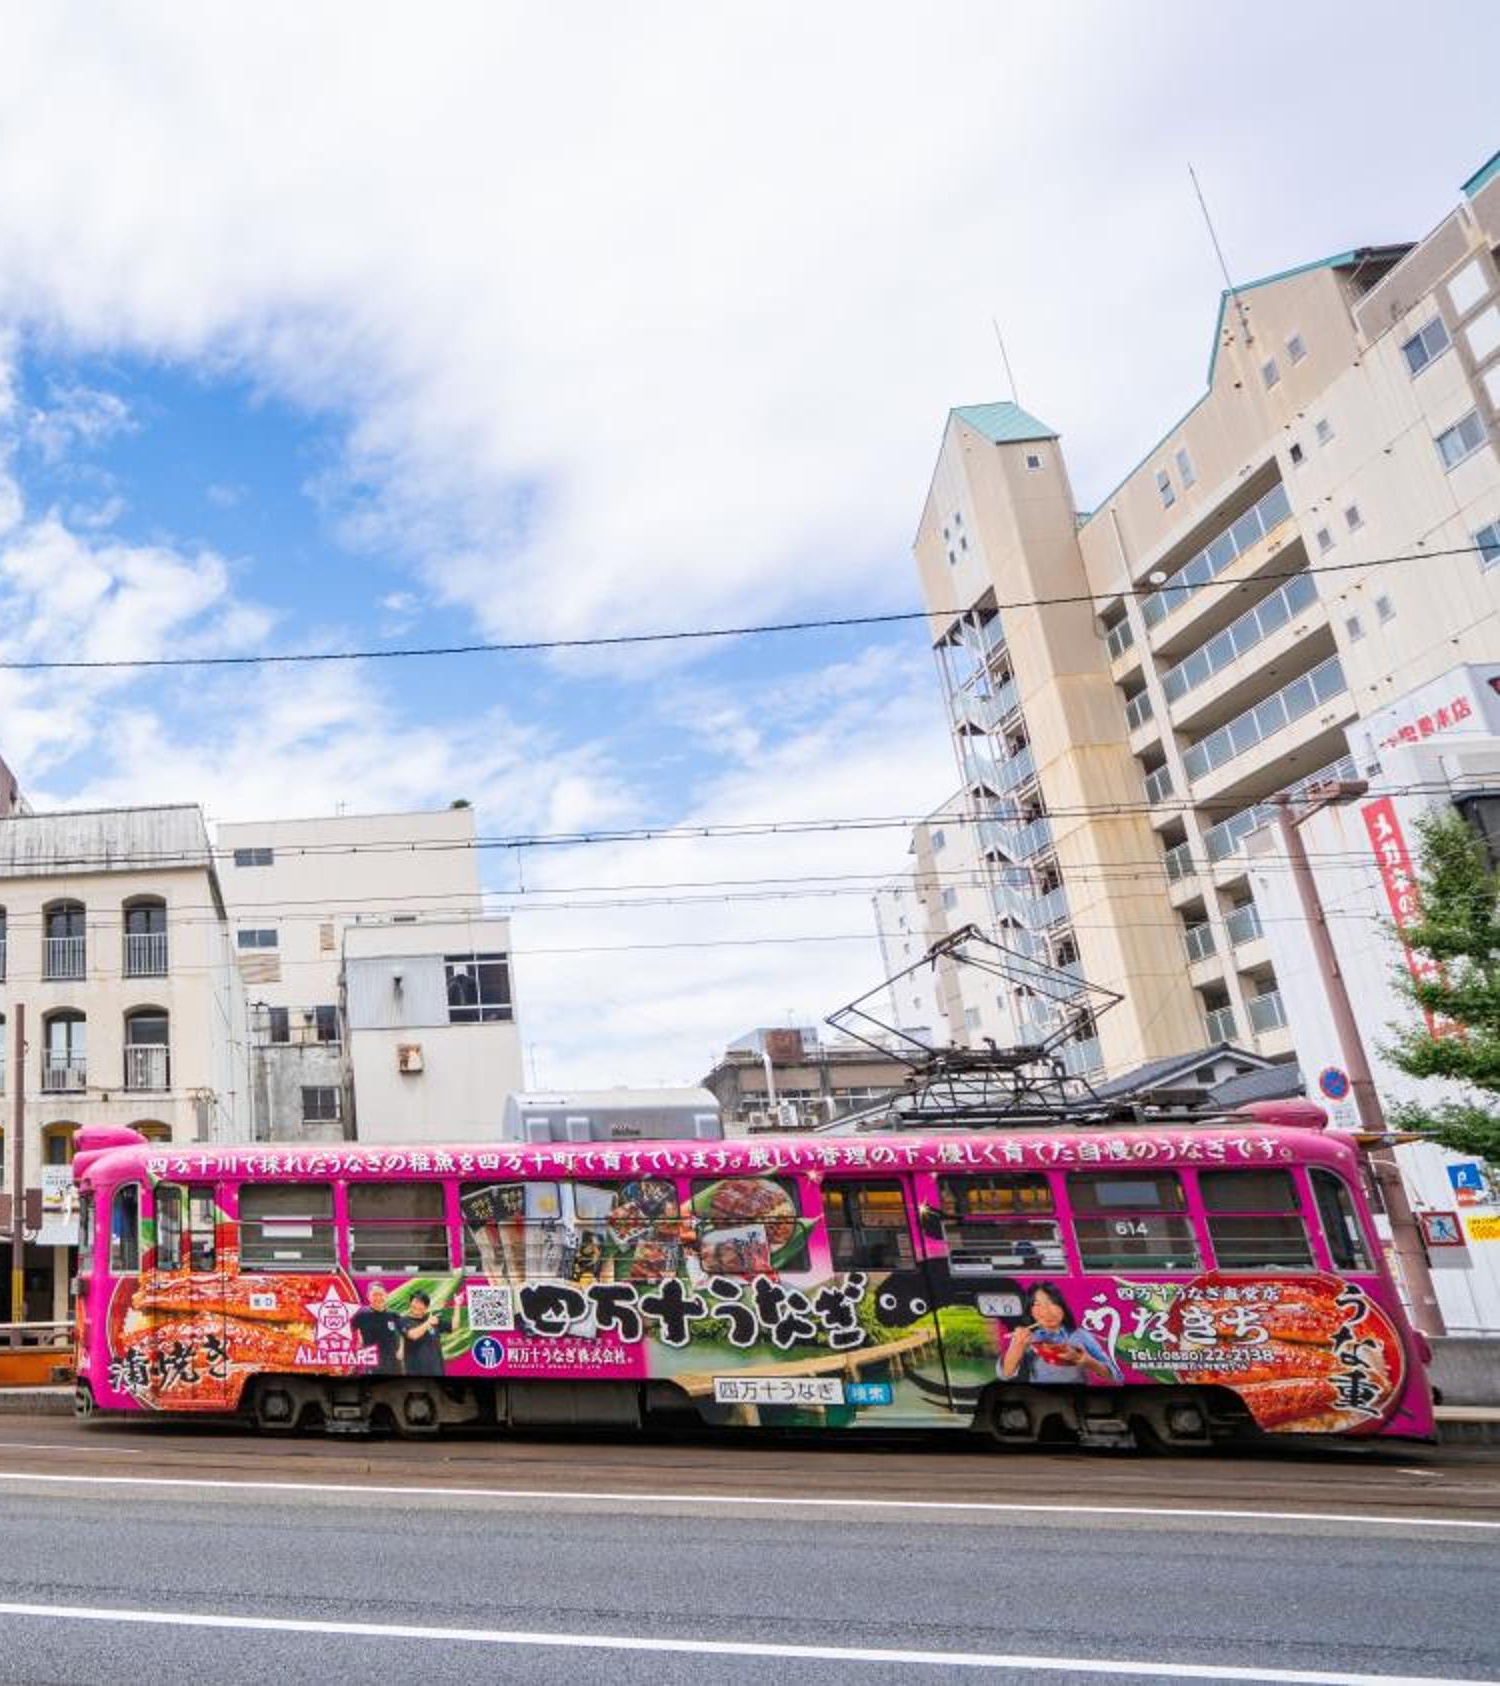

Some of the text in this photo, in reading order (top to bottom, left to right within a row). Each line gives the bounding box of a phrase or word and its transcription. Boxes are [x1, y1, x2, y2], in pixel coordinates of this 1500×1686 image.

[1115, 1221, 1149, 1237] 614
[1117, 1286, 1280, 1302] 四万十うなぎ直営店
[519, 1272, 867, 1349] 四万十うなぎ
[987, 1303, 1013, 1314] 入口
[1329, 1284, 1384, 1420] うな重
[717, 1381, 835, 1401] 四万十うなぎ
[851, 1383, 887, 1401] 検索
